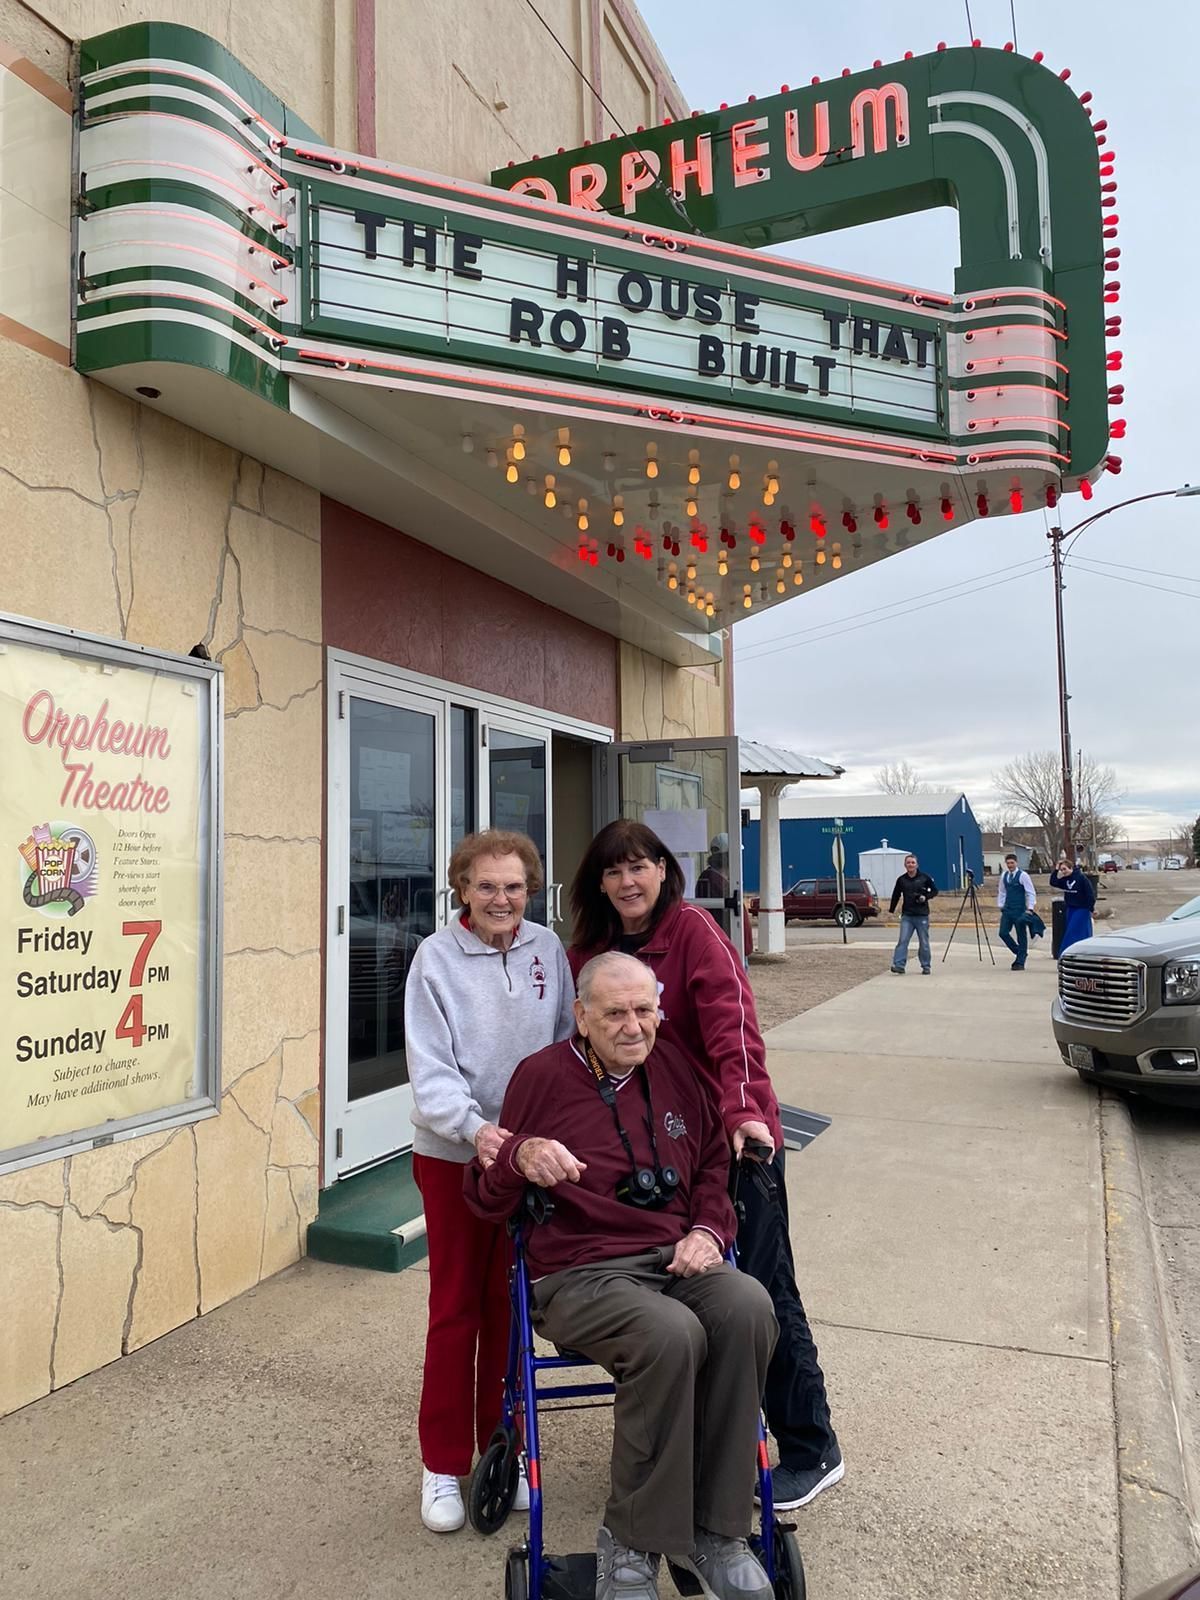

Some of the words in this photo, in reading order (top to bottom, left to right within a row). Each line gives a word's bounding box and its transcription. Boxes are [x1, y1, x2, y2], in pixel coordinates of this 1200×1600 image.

[355, 209, 484, 282] THE
[823, 308, 935, 369] THAT
[509, 297, 632, 361] ROB
[698, 333, 837, 397] BUILT
[23, 690, 170, 764] Orpheum
[60, 763, 170, 814] Theatre
[118, 829, 138, 838] Doors
[112, 842, 123, 851] 1/2
[124, 842, 141, 851] Hour
[142, 844, 162, 854] before
[44, 860, 63, 868] POP
[113, 856, 138, 865] Feature
[40, 869, 66, 877] CORN
[113, 870, 145, 879] Pre-views
[118, 884, 140, 895] shortly
[141, 883, 157, 895] after
[118, 898, 137, 907] doors
[138, 897, 157, 909] open!
[17, 926, 93, 955] Friday
[16, 965, 122, 998] Saturday
[122, 920, 162, 988] 7
[148, 965, 170, 983] PM
[1075, 976, 1104, 993] GMC
[16, 1028, 107, 1062] Sunday
[115, 993, 147, 1048] 4
[148, 1023, 170, 1042] PM
[53, 1062, 90, 1083] Subject
[92, 1061, 103, 1074] to
[105, 1057, 140, 1072] change.
[26, 1093, 51, 1108] May
[53, 1087, 79, 1102] have
[80, 1074, 130, 1097] additional
[131, 1070, 161, 1086] shows.
